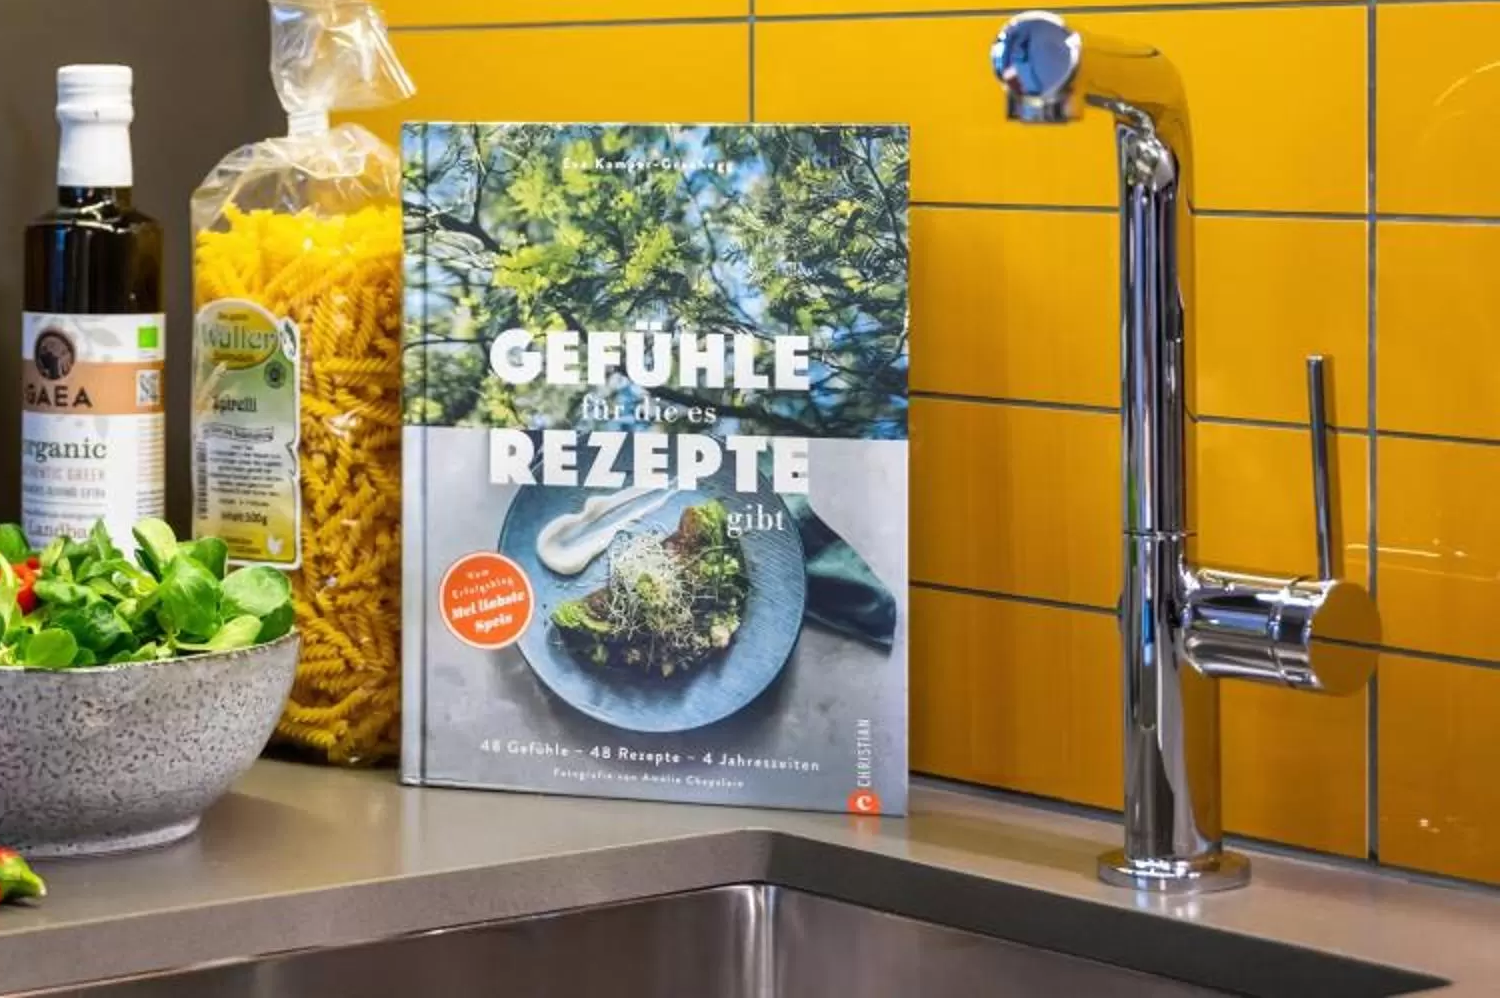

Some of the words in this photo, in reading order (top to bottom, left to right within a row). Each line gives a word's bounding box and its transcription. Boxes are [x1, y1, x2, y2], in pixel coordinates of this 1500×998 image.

[490, 322, 810, 390] GEFÜHLE
[24, 384, 94, 408] GAEA
[582, 393, 624, 422] für
[634, 395, 678, 423] die
[687, 405, 717, 424] es
[490, 428, 810, 494] REZEPTE
[726, 503, 785, 539] gibt
[480, 739, 500, 753] 48
[507, 740, 569, 757] Gefühle
[589, 745, 611, 759] 48
[619, 747, 681, 767] Rezepte
[702, 752, 713, 766] 4
[718, 753, 820, 772] Jahreszeiten
[856, 718, 871, 787] CHRISTIAN
